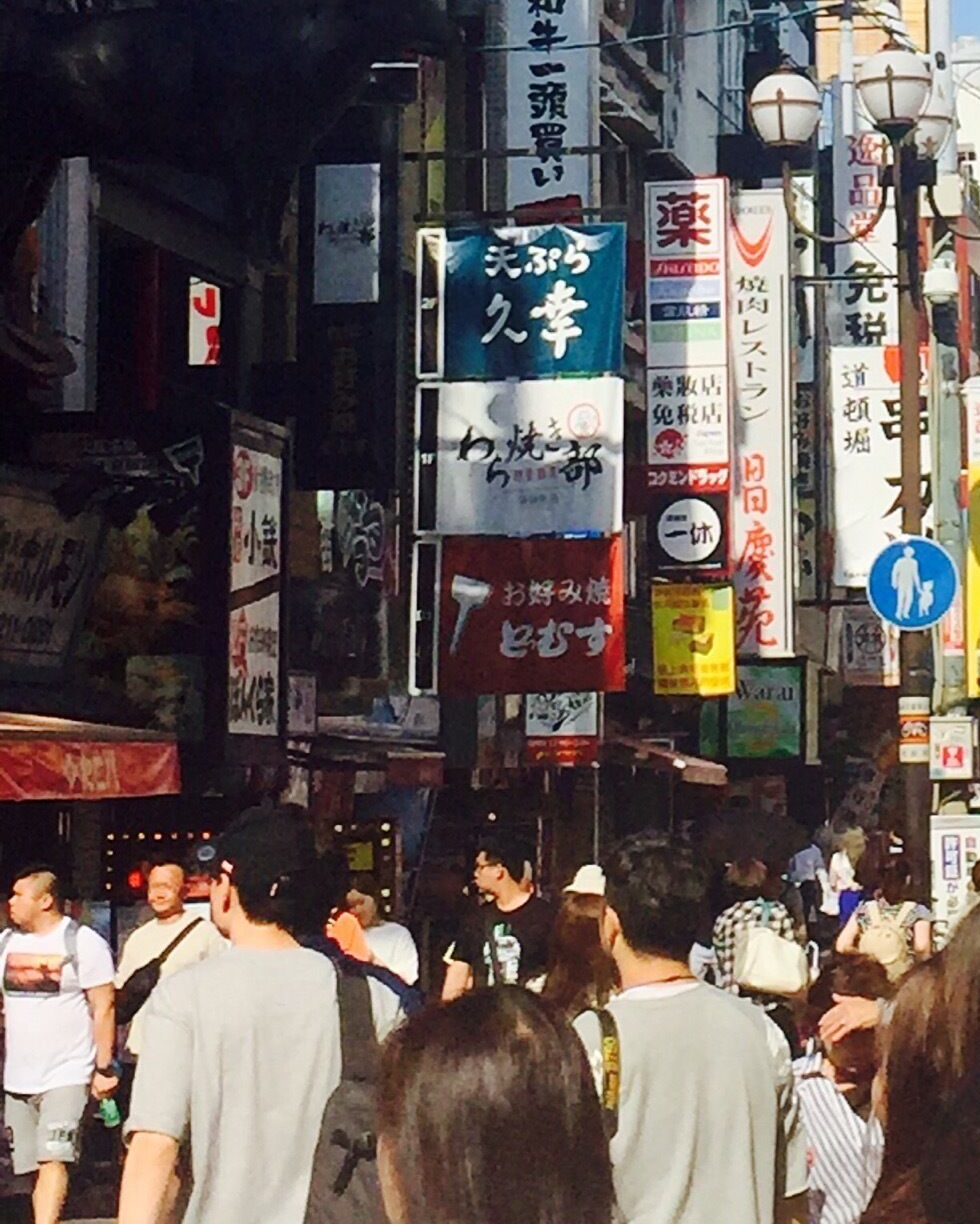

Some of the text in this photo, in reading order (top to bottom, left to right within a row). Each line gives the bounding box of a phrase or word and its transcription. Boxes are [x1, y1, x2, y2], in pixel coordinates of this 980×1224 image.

[656, 191, 711, 249] 薬
[484, 243, 591, 279] 天ぷら
[480, 279, 589, 360] 久幸
[844, 260, 888, 347] 免税
[735, 275, 771, 423] 焼肉レストラン
[842, 362, 871, 455] 道頓堀
[648, 467, 729, 486] コクミンドラッグ
[664, 522, 714, 546] 一休
[503, 576, 612, 607] お好み焼
